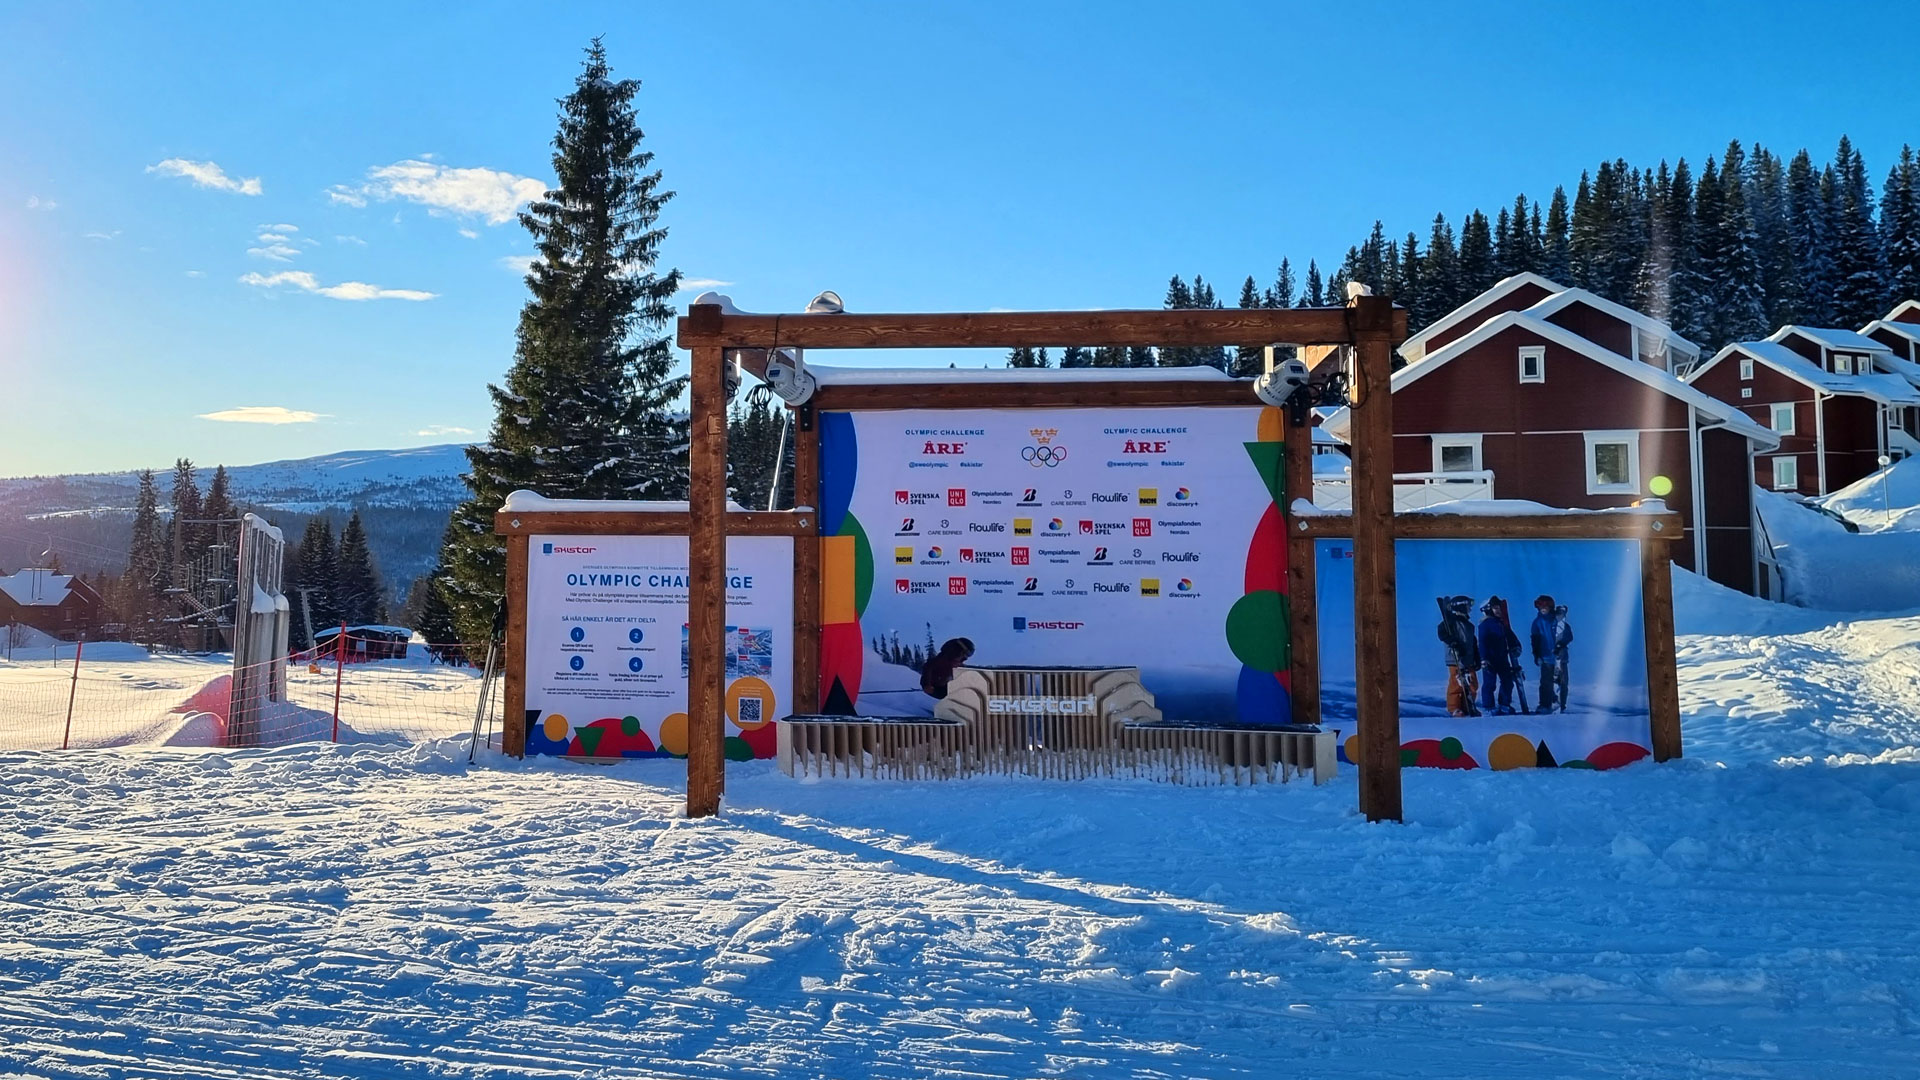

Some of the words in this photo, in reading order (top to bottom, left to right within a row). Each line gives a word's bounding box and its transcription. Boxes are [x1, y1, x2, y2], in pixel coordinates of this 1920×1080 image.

[1140, 427, 1188, 435] CHALLENGE
[949, 490, 964, 498] UNI
[1091, 492, 1128, 503] Flowlife
[969, 522, 1005, 533] Flowlife
[553, 546, 597, 554] skistar
[1161, 551, 1199, 562] Flowlife
[566, 573, 642, 588] OLYMPIC
[1093, 582, 1130, 593] Flowlife
[1028, 621, 1085, 630] skistar
